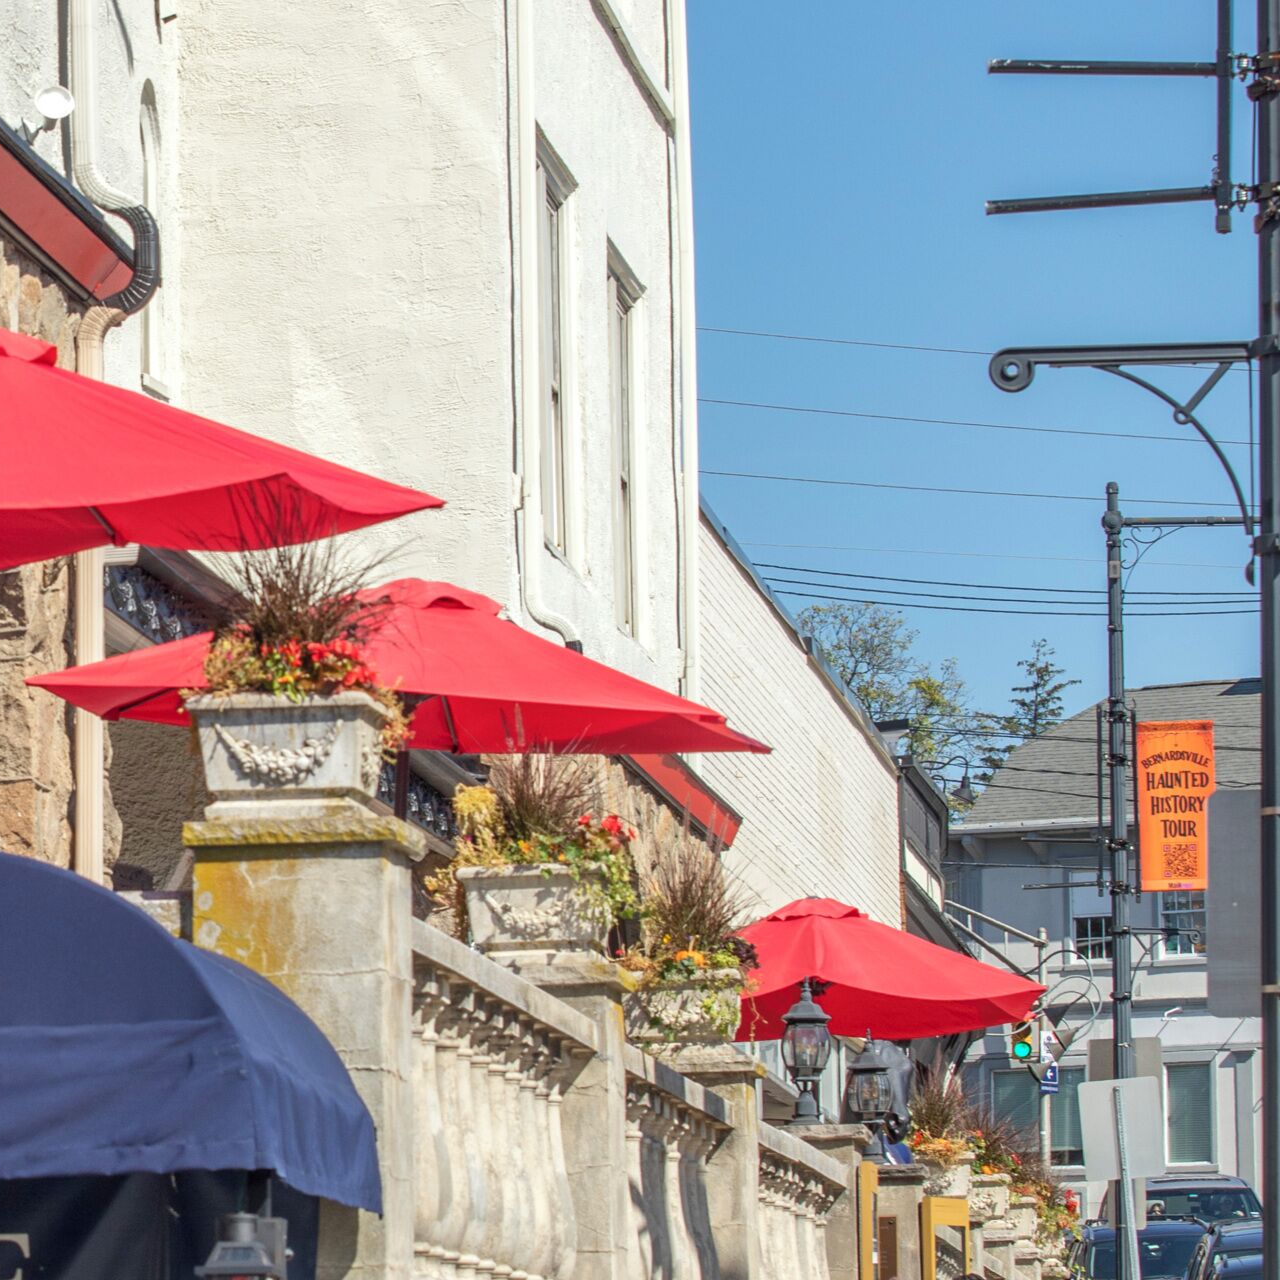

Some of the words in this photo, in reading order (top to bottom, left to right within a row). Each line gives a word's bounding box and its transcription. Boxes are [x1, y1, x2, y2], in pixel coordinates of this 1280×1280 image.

[1140, 750, 1212, 770] BERNARDSVILLE
[1145, 770, 1210, 792] HAUNTED
[1150, 794, 1206, 816] HISTORY
[1160, 819, 1198, 839] TOUR
